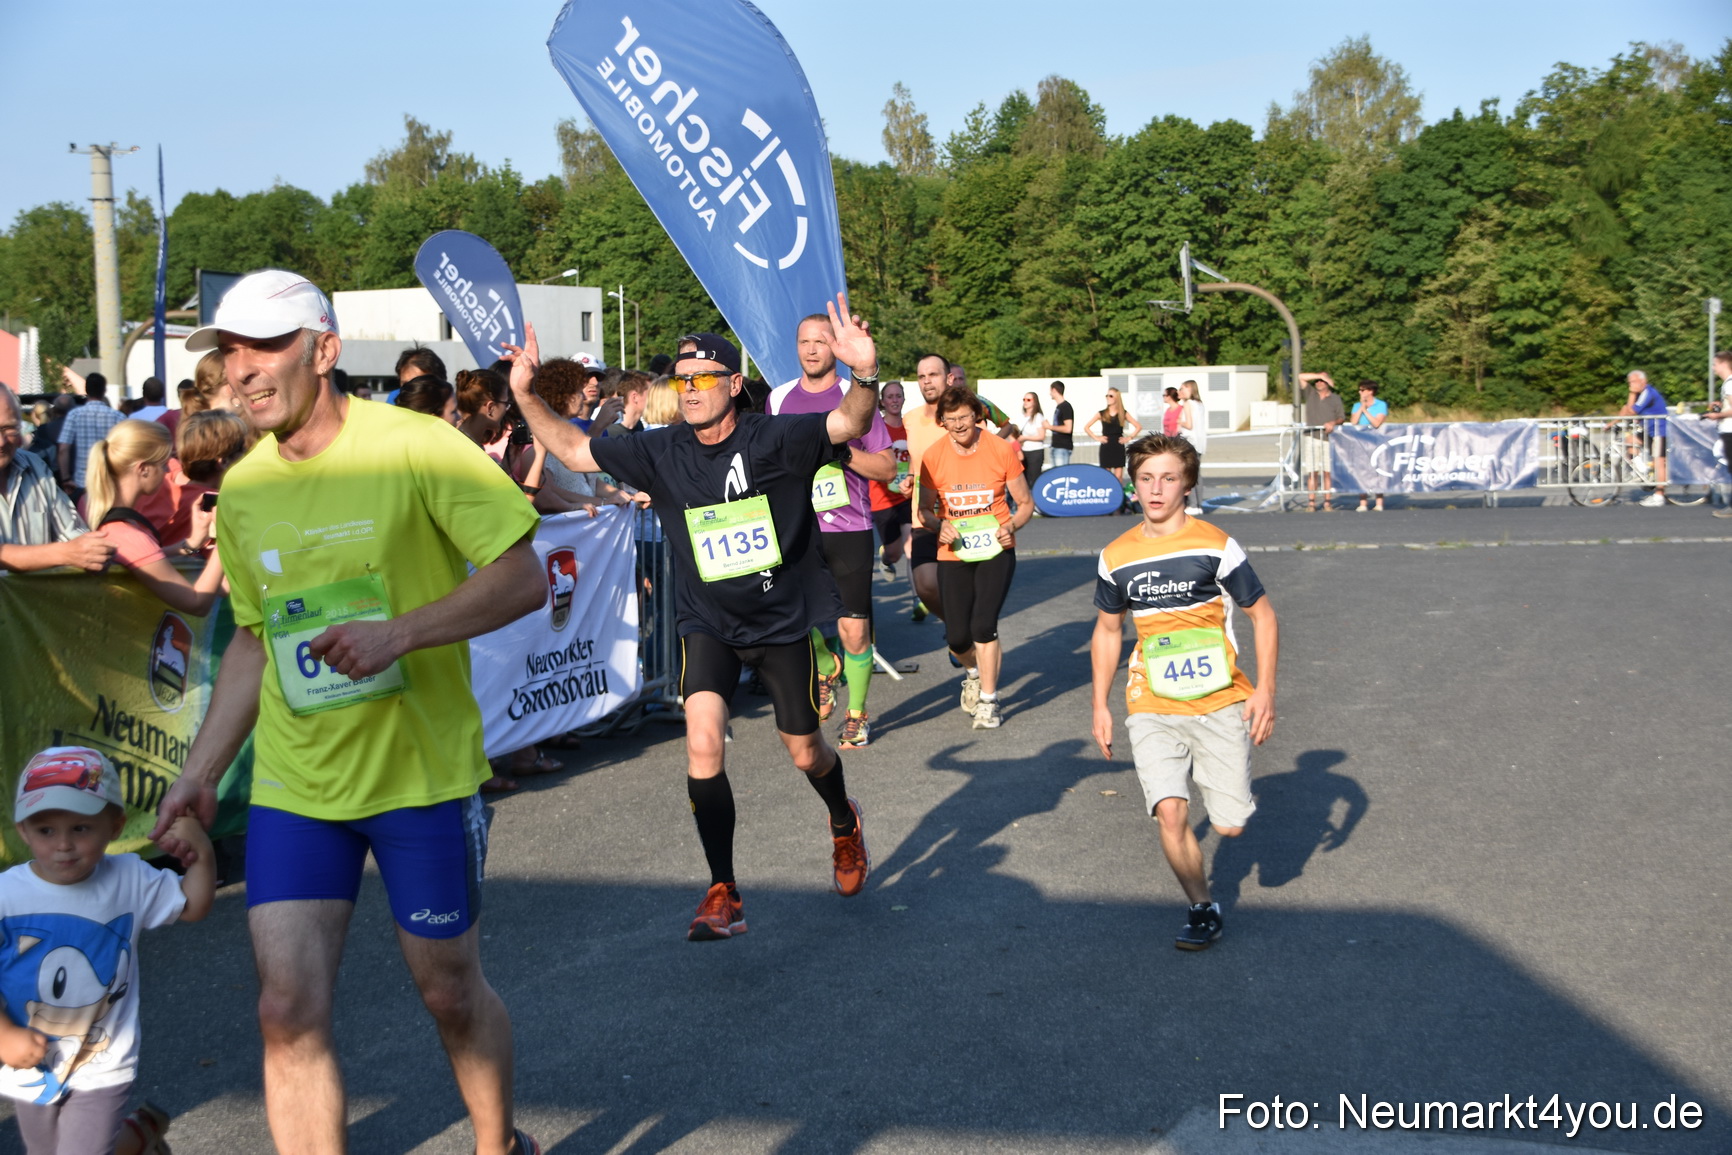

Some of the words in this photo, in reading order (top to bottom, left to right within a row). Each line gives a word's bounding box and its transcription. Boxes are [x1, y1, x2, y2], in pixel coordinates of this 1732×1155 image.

[1393, 451, 1495, 472] Fischer
[1402, 471, 1486, 482] AUTOMOBILE
[811, 482, 836, 499] 12
[1055, 485, 1113, 499] Fischer
[949, 494, 991, 507] OBI
[701, 527, 769, 561] 1135
[962, 533, 992, 549] 623
[1138, 580, 1197, 597] Fischer
[526, 637, 595, 679] Neumarkter
[1163, 655, 1213, 682] 445
[306, 680, 352, 696] Franz-Xaver
[427, 909, 460, 924] asics
